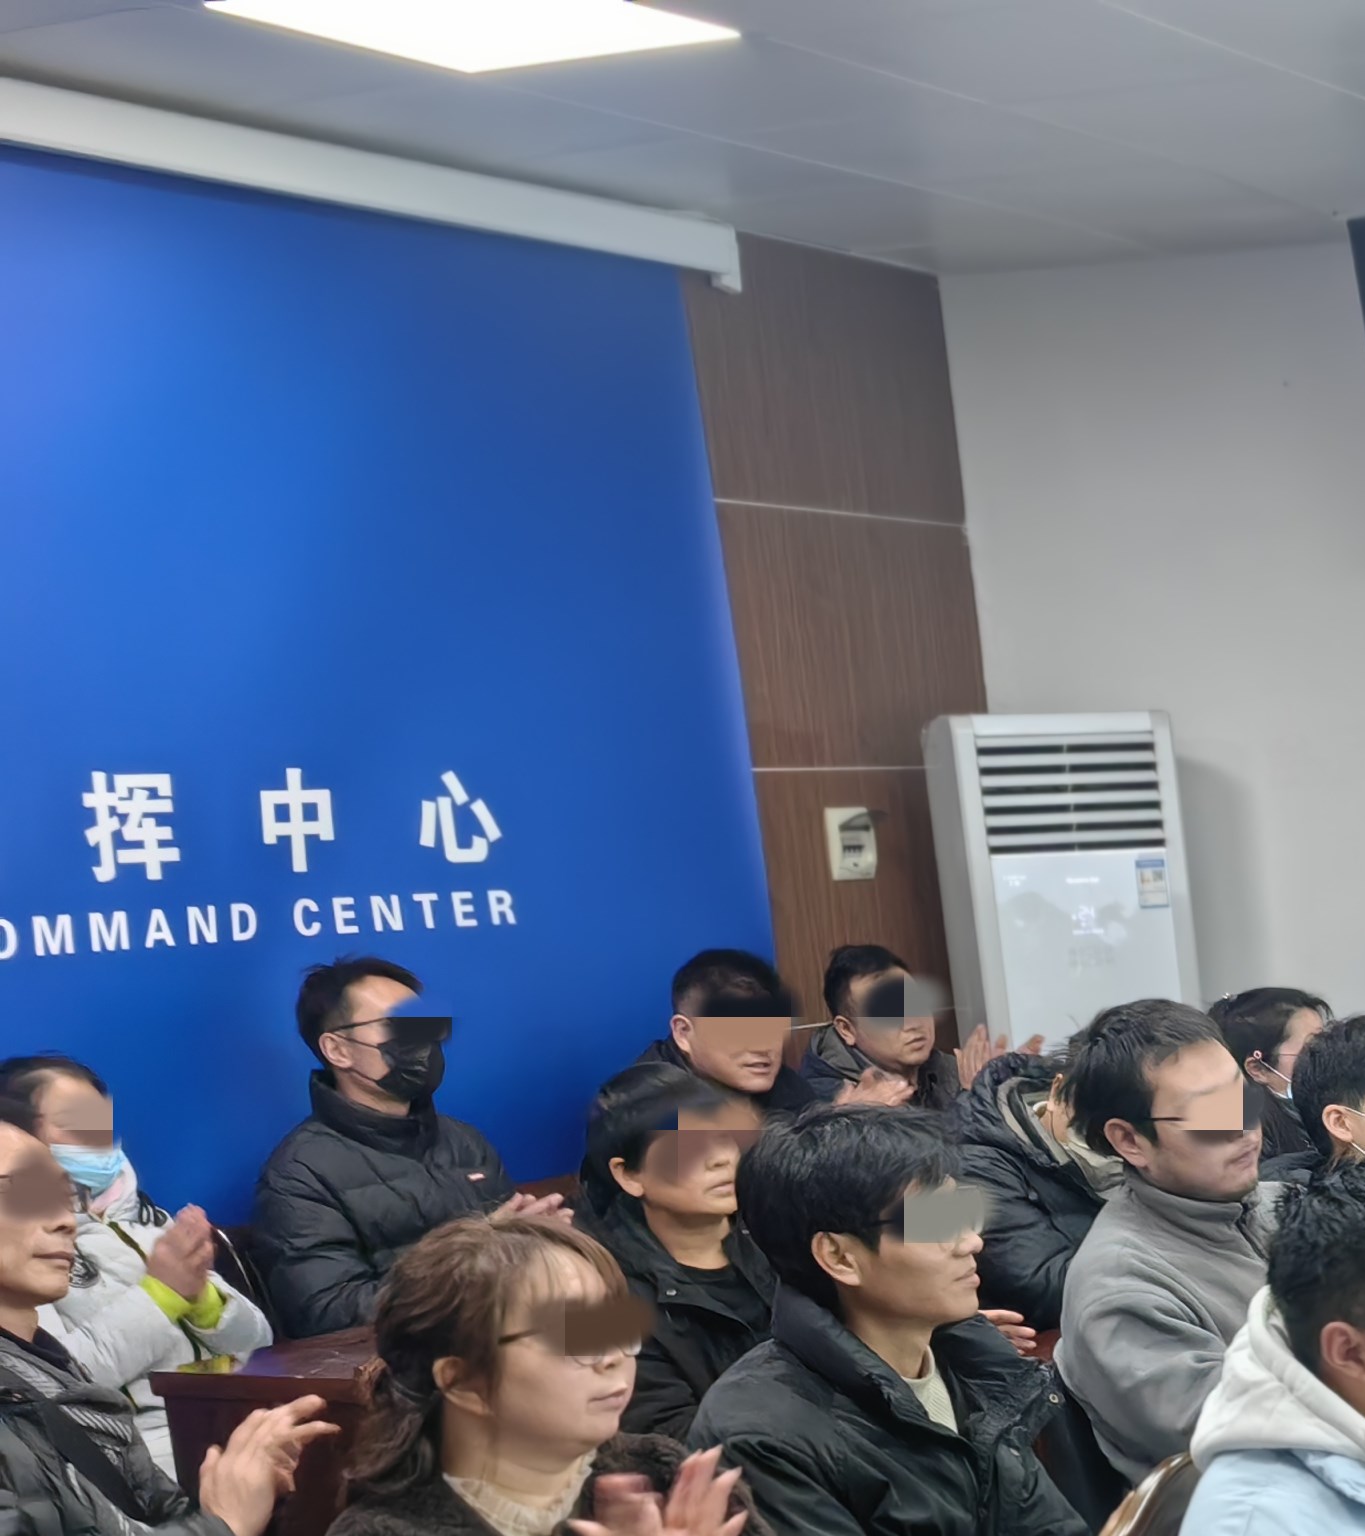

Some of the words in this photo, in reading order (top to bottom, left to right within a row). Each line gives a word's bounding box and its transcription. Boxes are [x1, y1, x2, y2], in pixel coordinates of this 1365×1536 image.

[82, 768, 502, 882] 挥中心
[294, 889, 517, 936] CENTER
